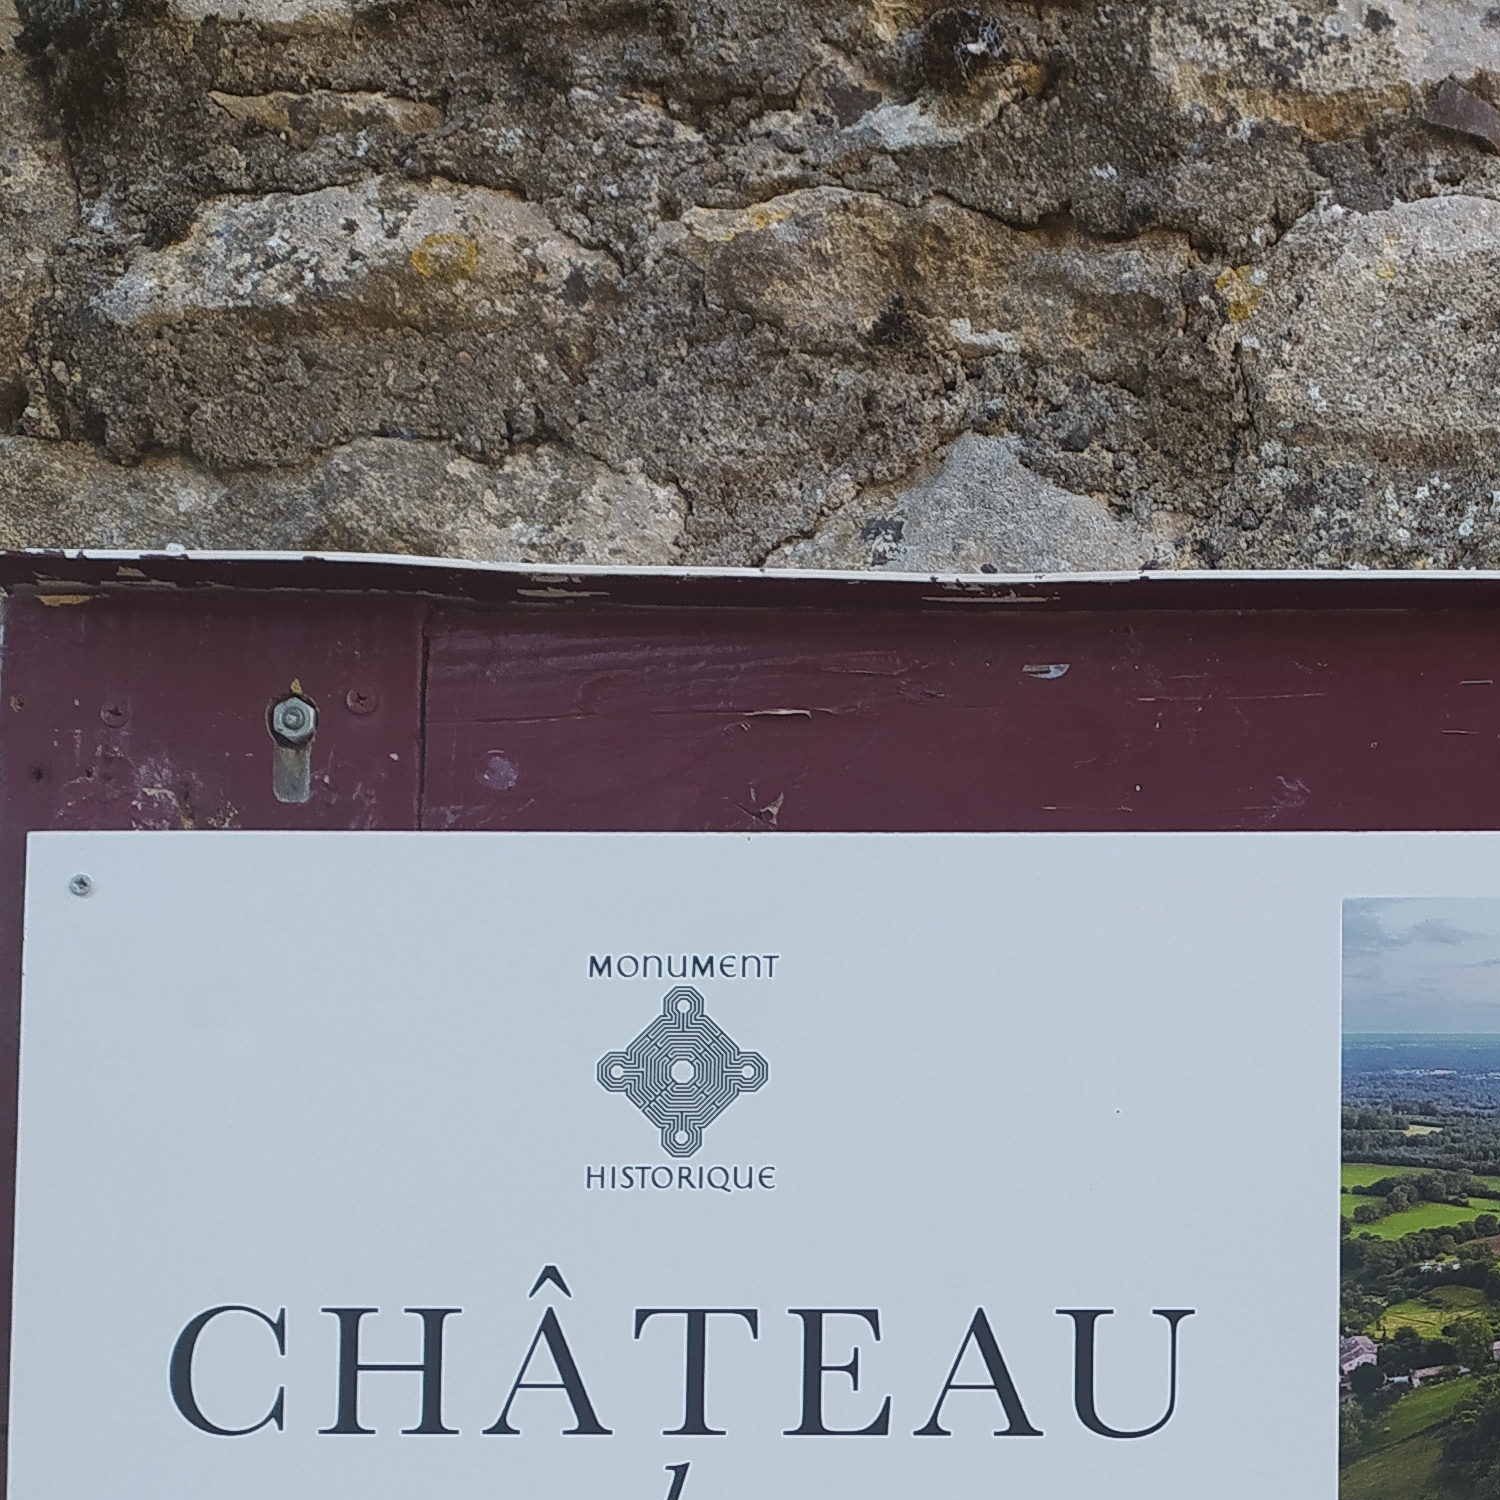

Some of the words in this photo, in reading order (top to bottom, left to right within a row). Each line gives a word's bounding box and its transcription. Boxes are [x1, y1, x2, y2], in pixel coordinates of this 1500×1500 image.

[589, 955, 780, 978] MONUMENT
[586, 1166, 776, 1193] HISTORIQUE
[169, 1265, 1196, 1439] CHÂTEAU
